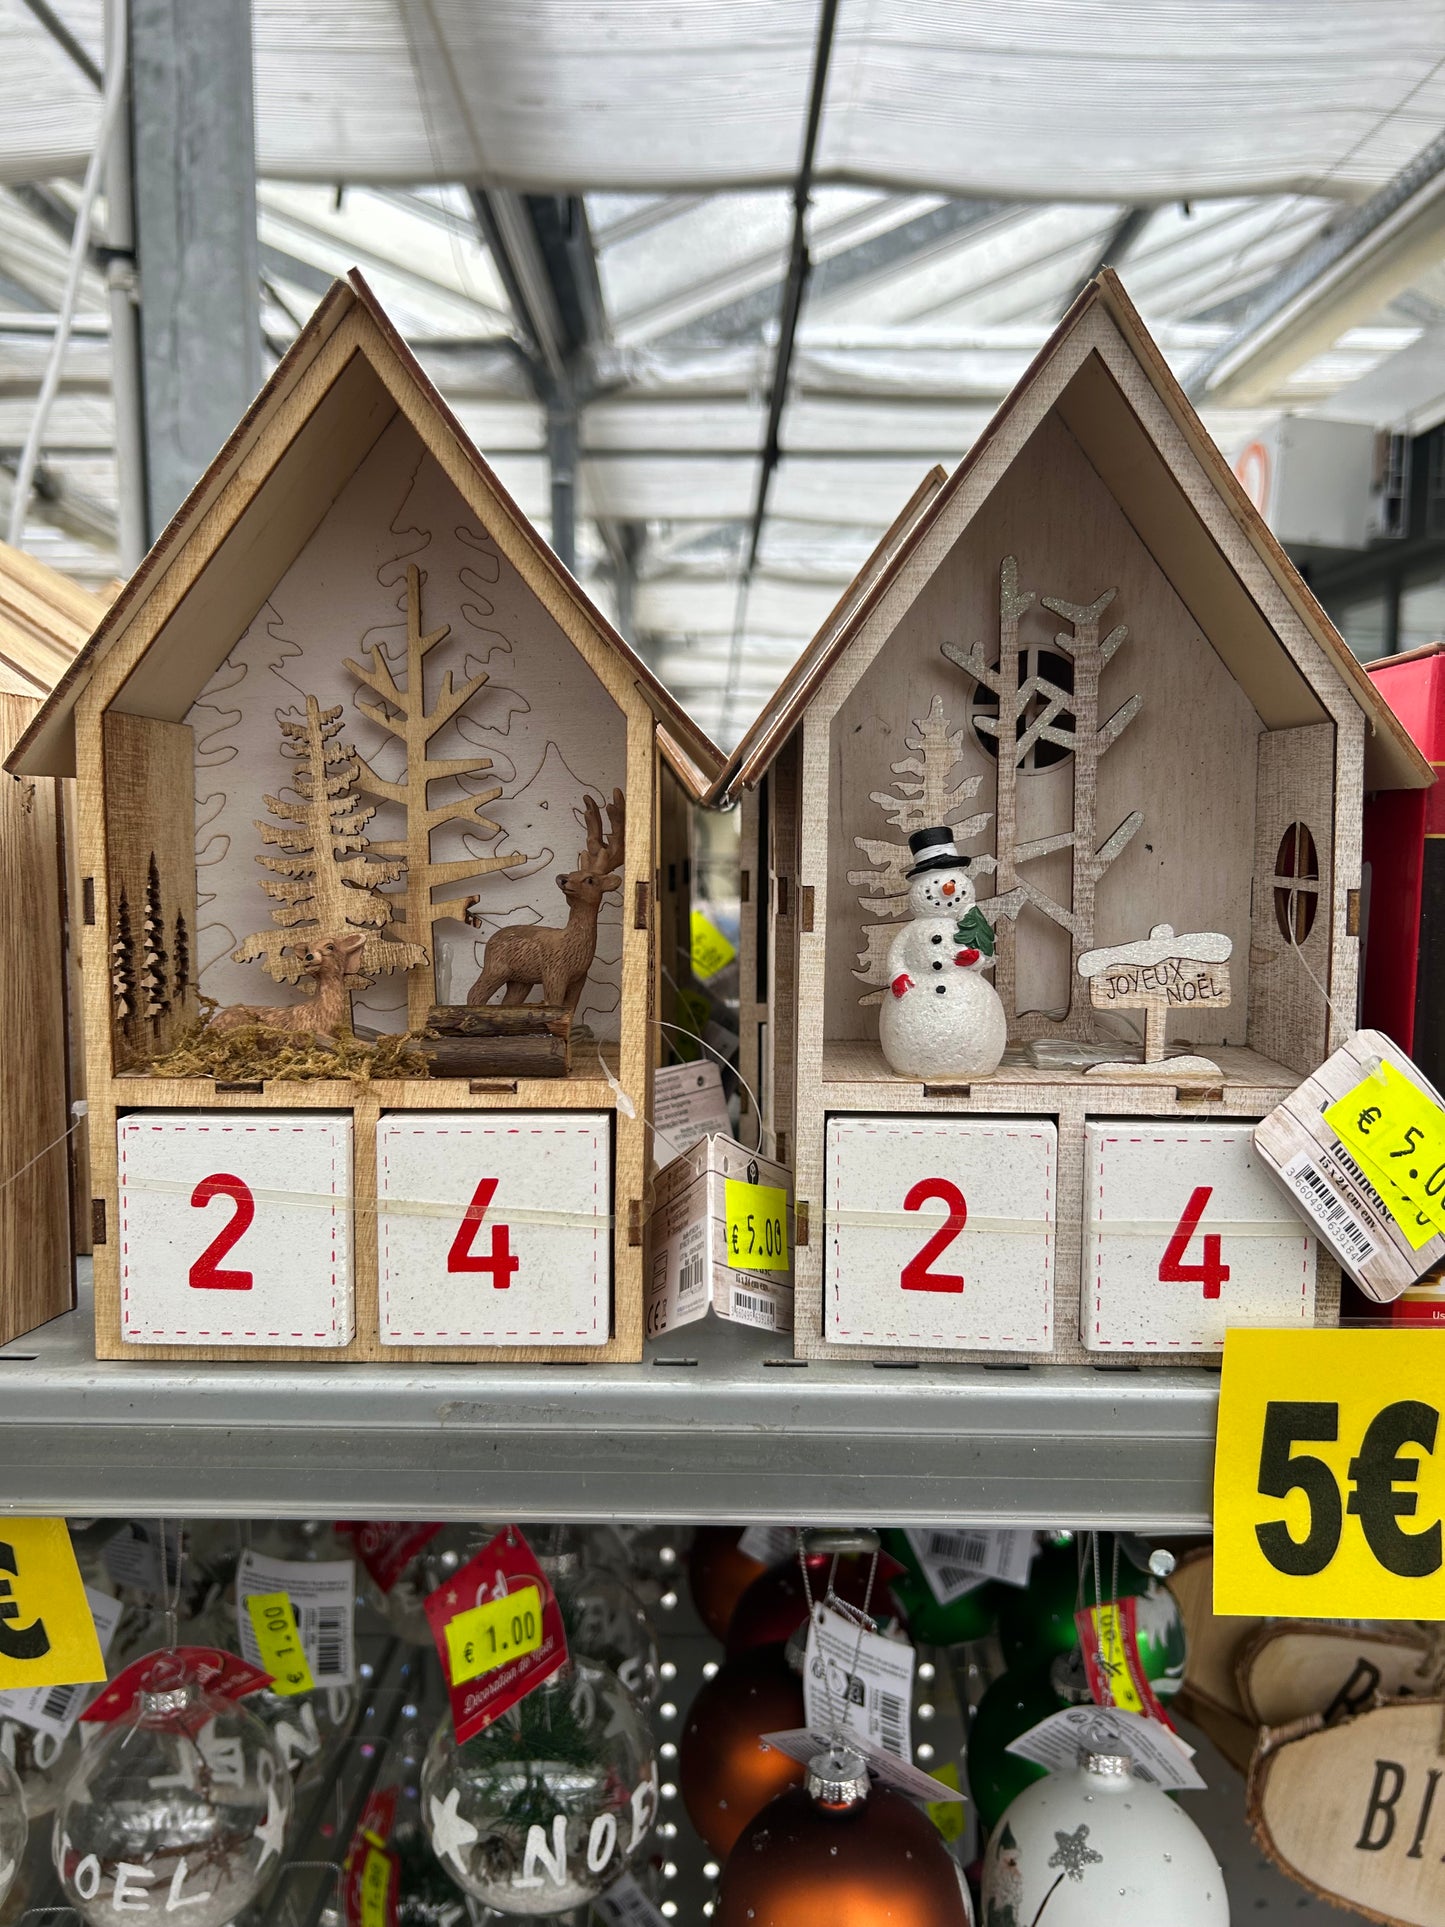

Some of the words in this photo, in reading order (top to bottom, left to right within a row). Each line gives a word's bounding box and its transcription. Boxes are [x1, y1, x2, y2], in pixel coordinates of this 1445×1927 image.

[1106, 959, 1184, 999] JOYEUX
[1166, 973, 1223, 1005] NOËL
[1319, 1155, 1332, 1169] 15
[1328, 1169, 1338, 1178] x
[1335, 1176, 1349, 1191] 24
[1346, 1191, 1362, 1210] cm
[1360, 1209, 1376, 1233] env.
[1329, 1140, 1396, 1225] lumineuse
[188, 1173, 256, 1290] 2
[447, 1177, 519, 1288] 4
[747, 1215, 782, 1257] 5.00
[900, 1177, 968, 1294] 2
[1158, 1186, 1230, 1299] 4
[1255, 1400, 1443, 1577] 5€
[263, 1606, 296, 1659] 1.00
[486, 1611, 535, 1654] 1.00
